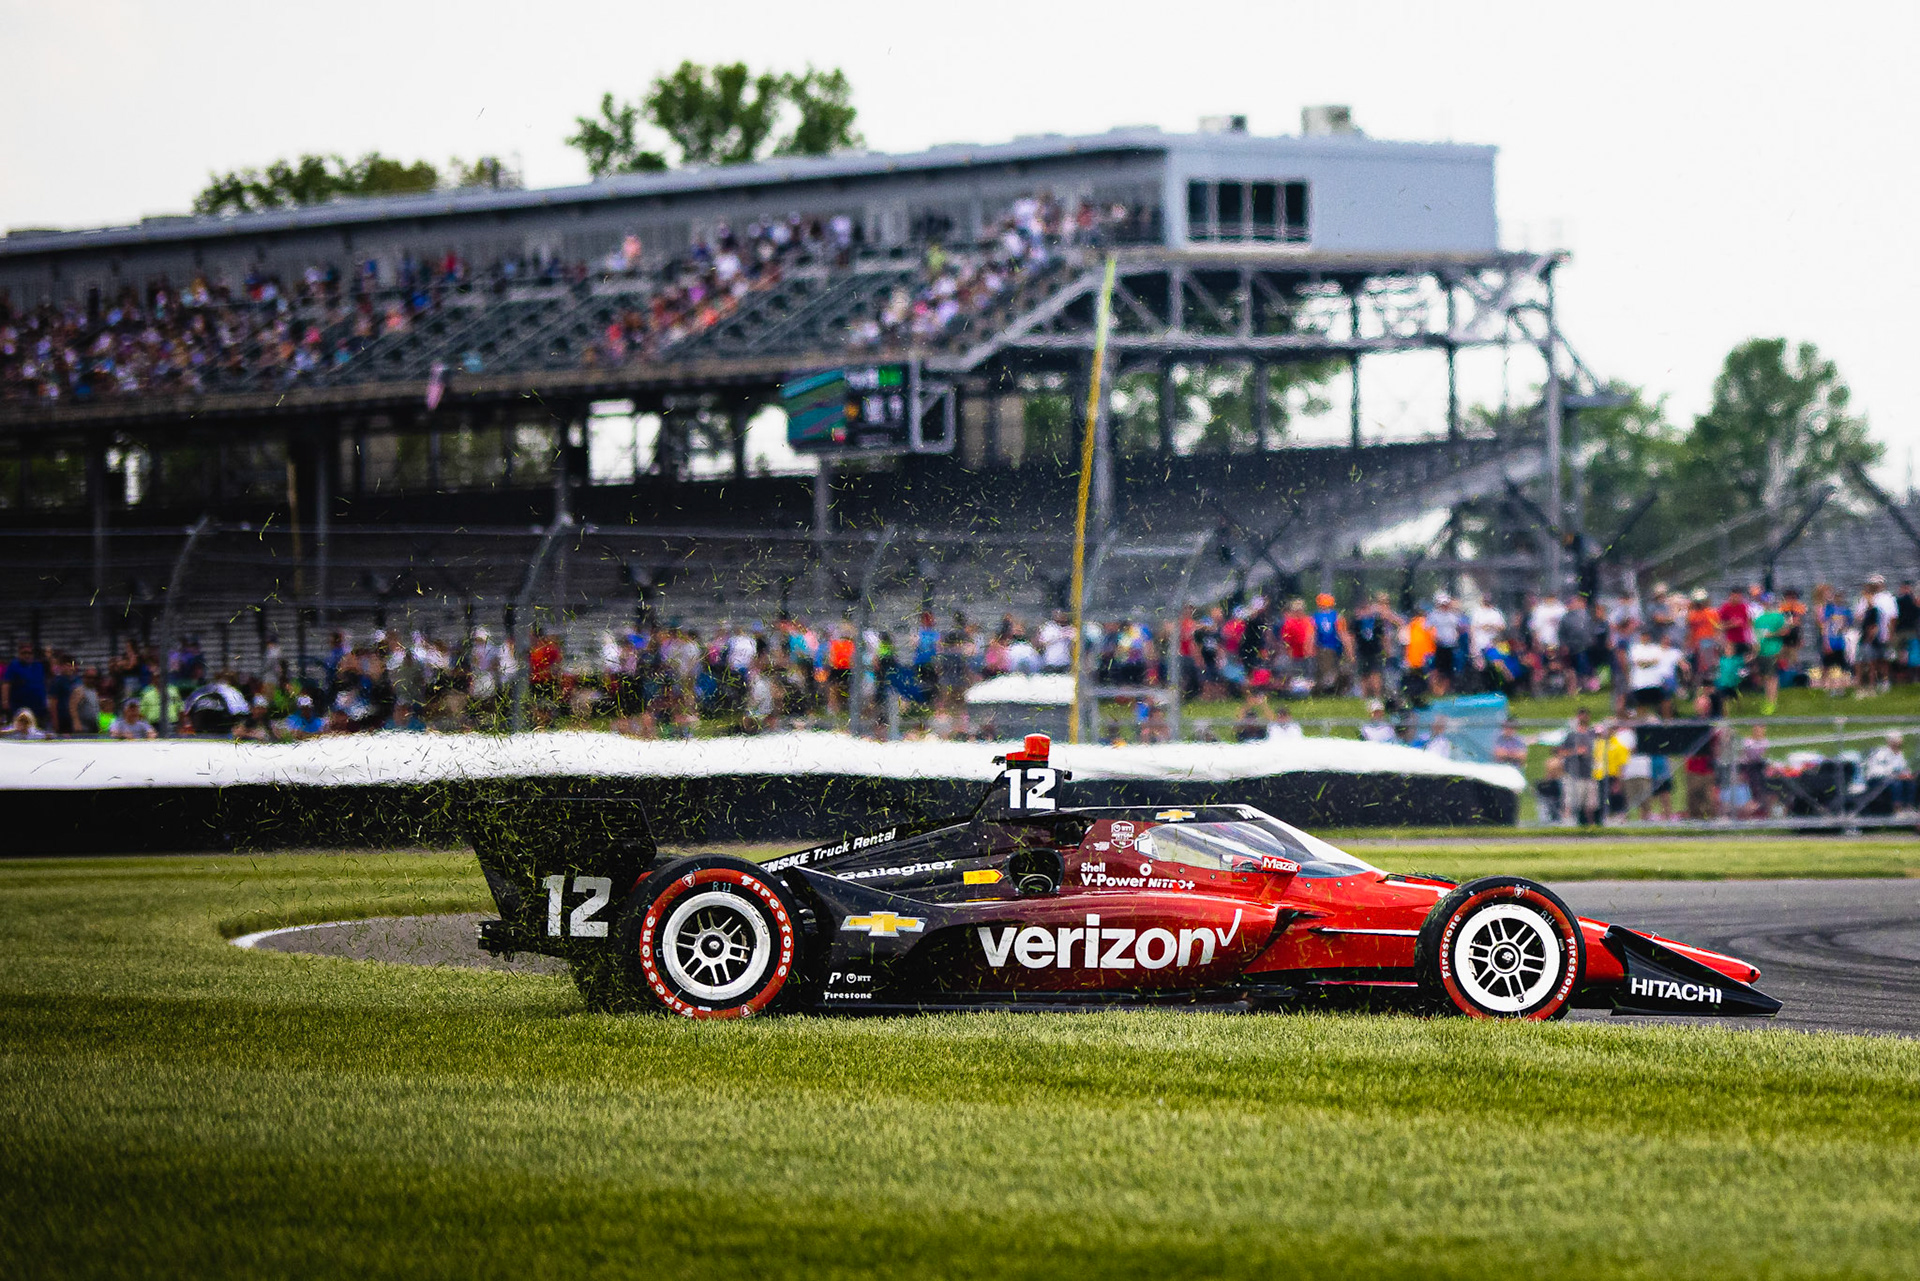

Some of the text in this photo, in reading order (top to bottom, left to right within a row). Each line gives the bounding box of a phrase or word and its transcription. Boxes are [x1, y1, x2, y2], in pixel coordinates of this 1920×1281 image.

[1004, 768, 1056, 810] 12
[759, 827, 897, 874] ENSKE Truck Rental
[836, 859, 957, 880] Gallagher
[1080, 862, 1106, 873] Shell
[1263, 857, 1299, 873] Mazak
[1080, 873, 1147, 887] V-Power
[542, 874, 613, 938] 12
[741, 874, 794, 978] Firestone
[976, 913, 1217, 969] verizon
[1441, 913, 1463, 980] Firestone
[640, 915, 695, 1018] Firestone
[857, 974, 872, 982] NTT
[1556, 936, 1577, 1001] Firestone
[823, 990, 873, 1000] Firestone
[1630, 977, 1723, 1004] HITACHI
